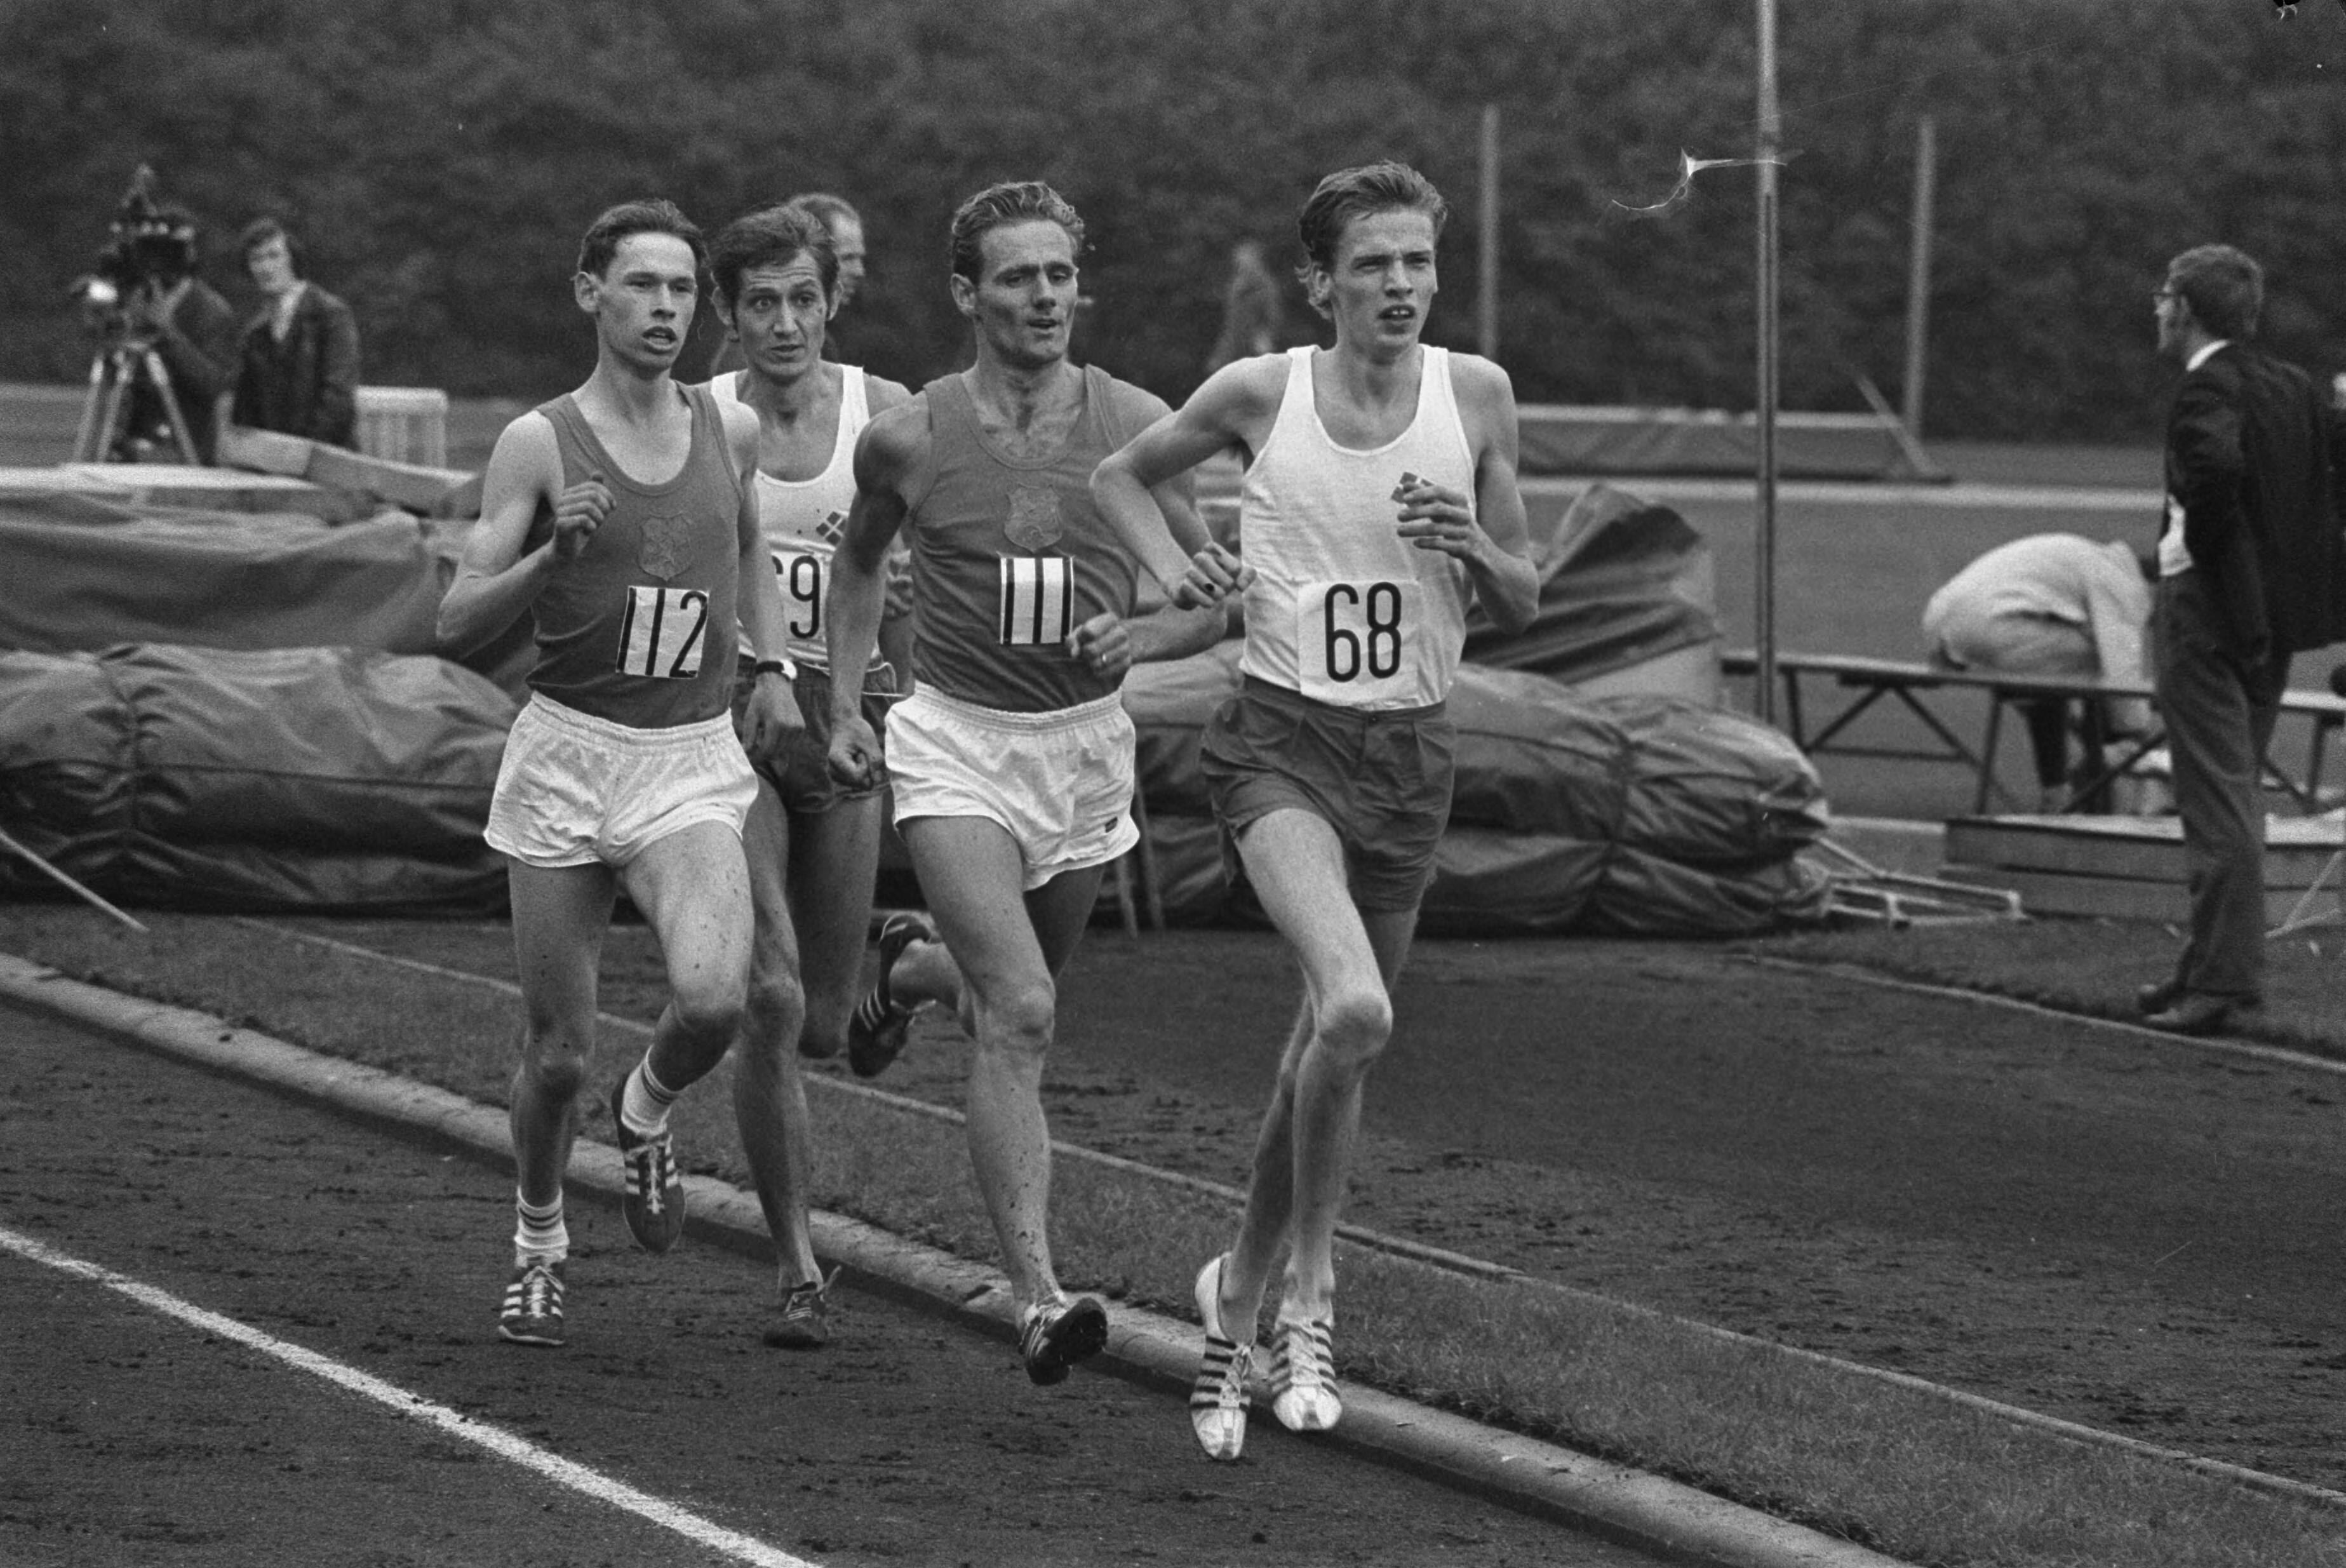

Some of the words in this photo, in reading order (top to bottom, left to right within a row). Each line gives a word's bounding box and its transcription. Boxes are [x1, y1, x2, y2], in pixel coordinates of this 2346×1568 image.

[617, 587, 707, 678] 112
[772, 555, 820, 639] 9
[1003, 556, 1074, 644] 111
[1324, 581, 1402, 683] 68
